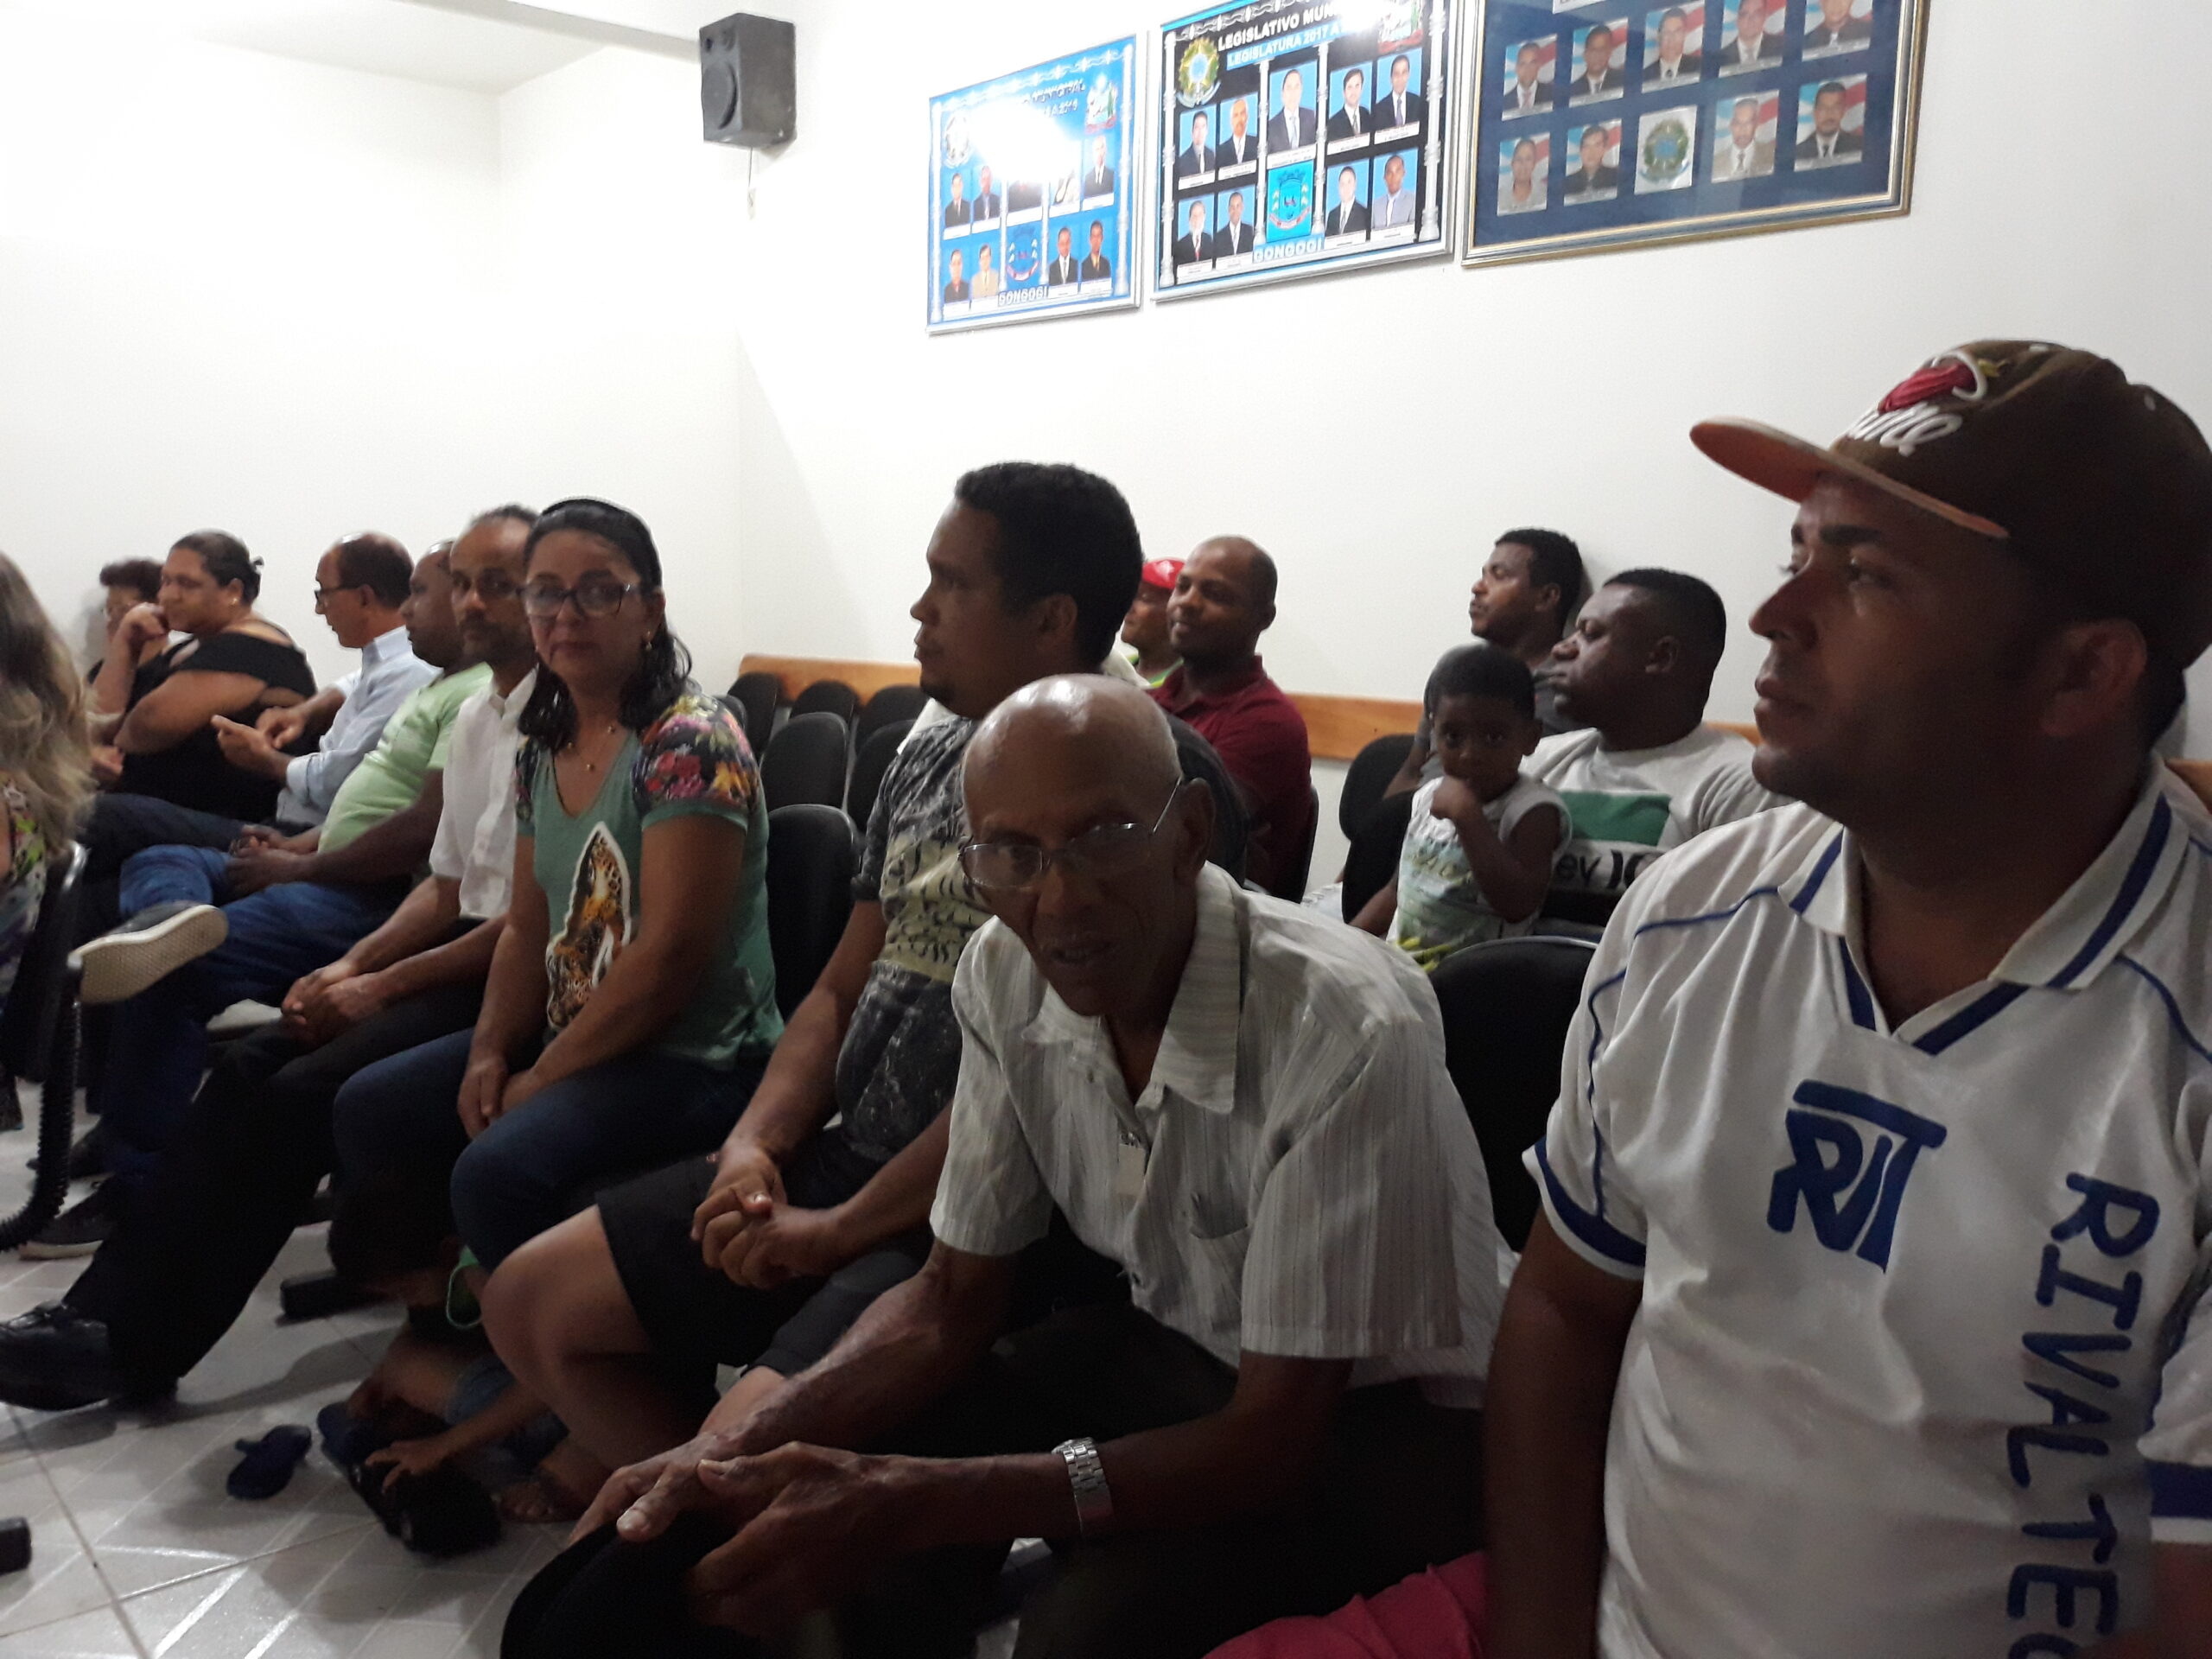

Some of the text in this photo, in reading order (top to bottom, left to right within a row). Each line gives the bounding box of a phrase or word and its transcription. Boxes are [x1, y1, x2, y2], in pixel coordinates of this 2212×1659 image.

[1217, 13, 1300, 51] LEGISLATIVO
[1228, 36, 1301, 66] LEGISLATURA
[1303, 27, 1330, 43] 2017
[1254, 238, 1324, 263] GONGOGI
